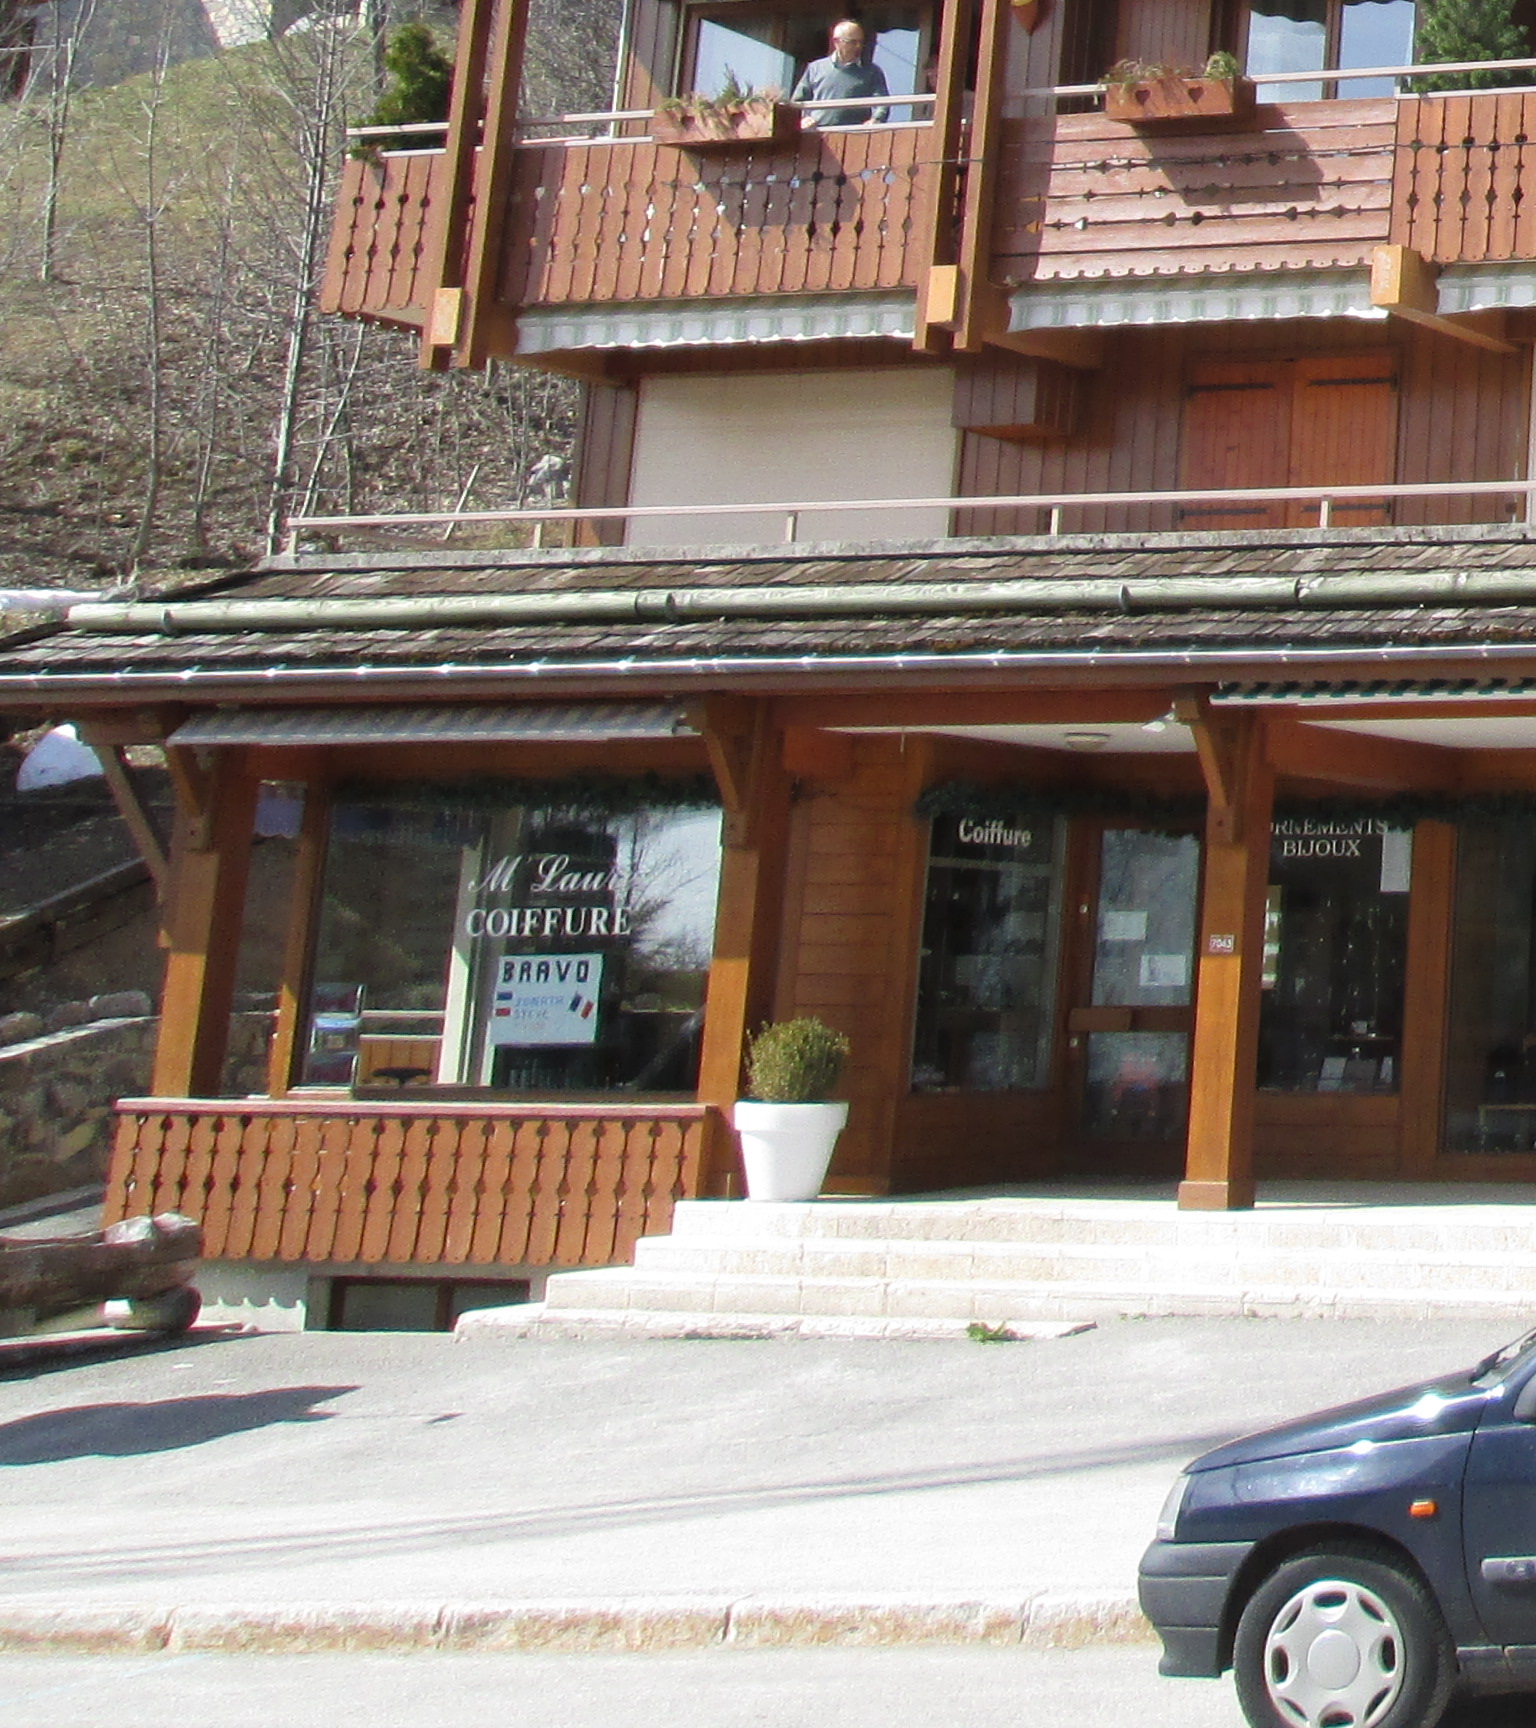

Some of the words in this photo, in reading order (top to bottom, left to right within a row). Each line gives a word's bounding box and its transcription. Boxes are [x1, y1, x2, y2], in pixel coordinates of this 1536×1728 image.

[958, 818, 1032, 847] Coiffure
[1270, 818, 1388, 835] RNEMENTS
[1283, 839, 1361, 857] BIJOUX
[466, 907, 632, 937] COIFFURE
[502, 960, 590, 983] BRAVO
